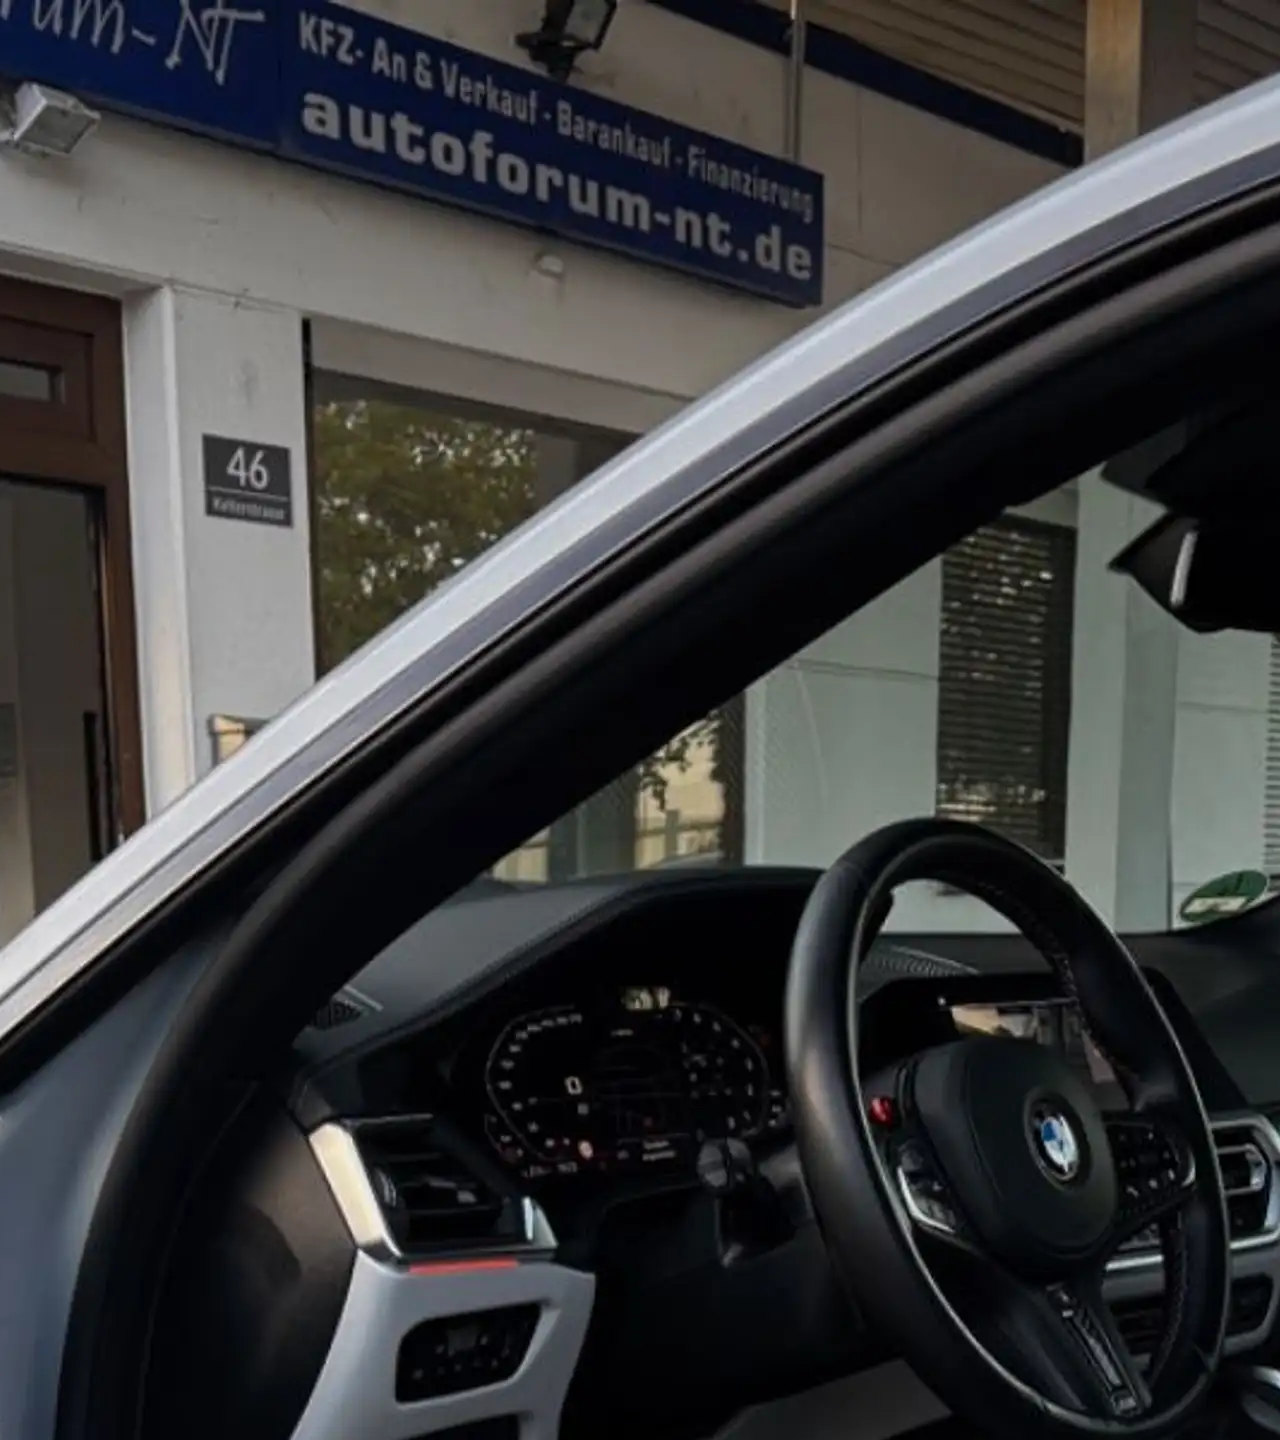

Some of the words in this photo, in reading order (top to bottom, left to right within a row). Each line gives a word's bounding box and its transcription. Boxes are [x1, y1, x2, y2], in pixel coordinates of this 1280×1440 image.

[302, 92, 812, 281] autoforum-nt.de
[372, 37, 407, 83] An
[414, 50, 434, 90] &
[440, 58, 539, 126] Verkauf
[557, 99, 672, 168] Barankauf
[688, 143, 814, 225] Finanzierung
[226, 446, 269, 490] 46
